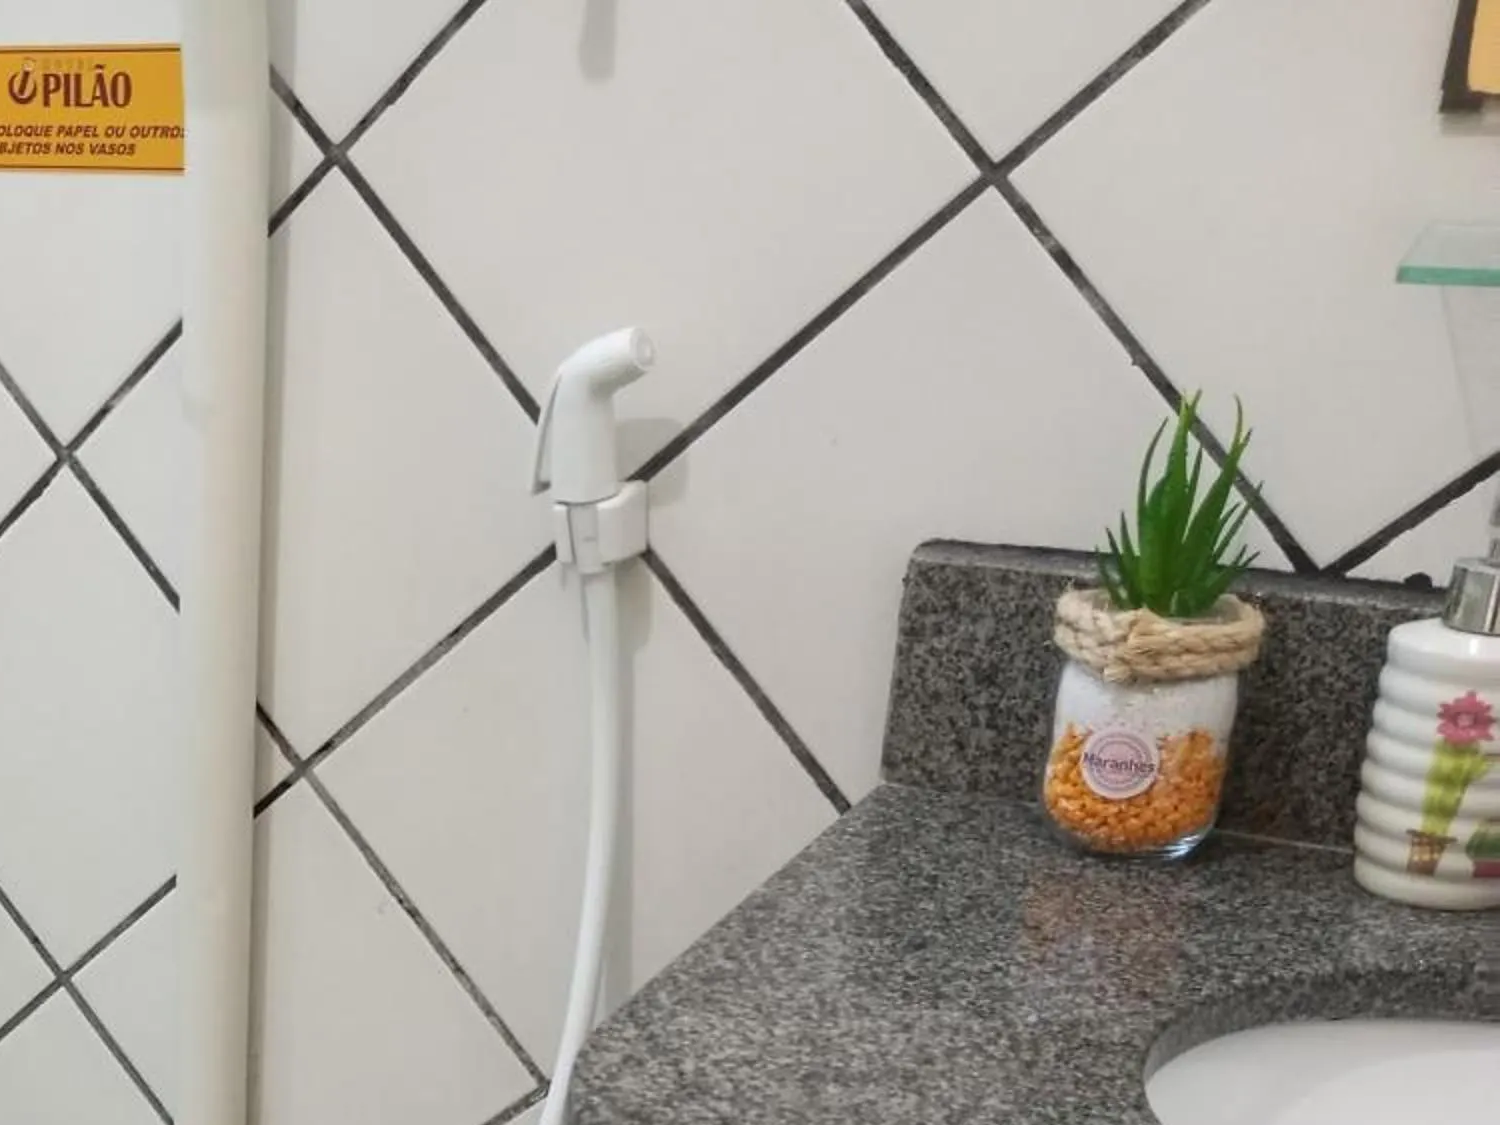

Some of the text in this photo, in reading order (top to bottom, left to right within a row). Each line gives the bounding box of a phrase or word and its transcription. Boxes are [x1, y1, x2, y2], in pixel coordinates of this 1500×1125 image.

[42, 64, 132, 108] PILÃO
[56, 125, 99, 138] PAPEL
[104, 125, 126, 138] OU
[55, 142, 84, 155] NOS
[89, 143, 136, 155] VASOS
